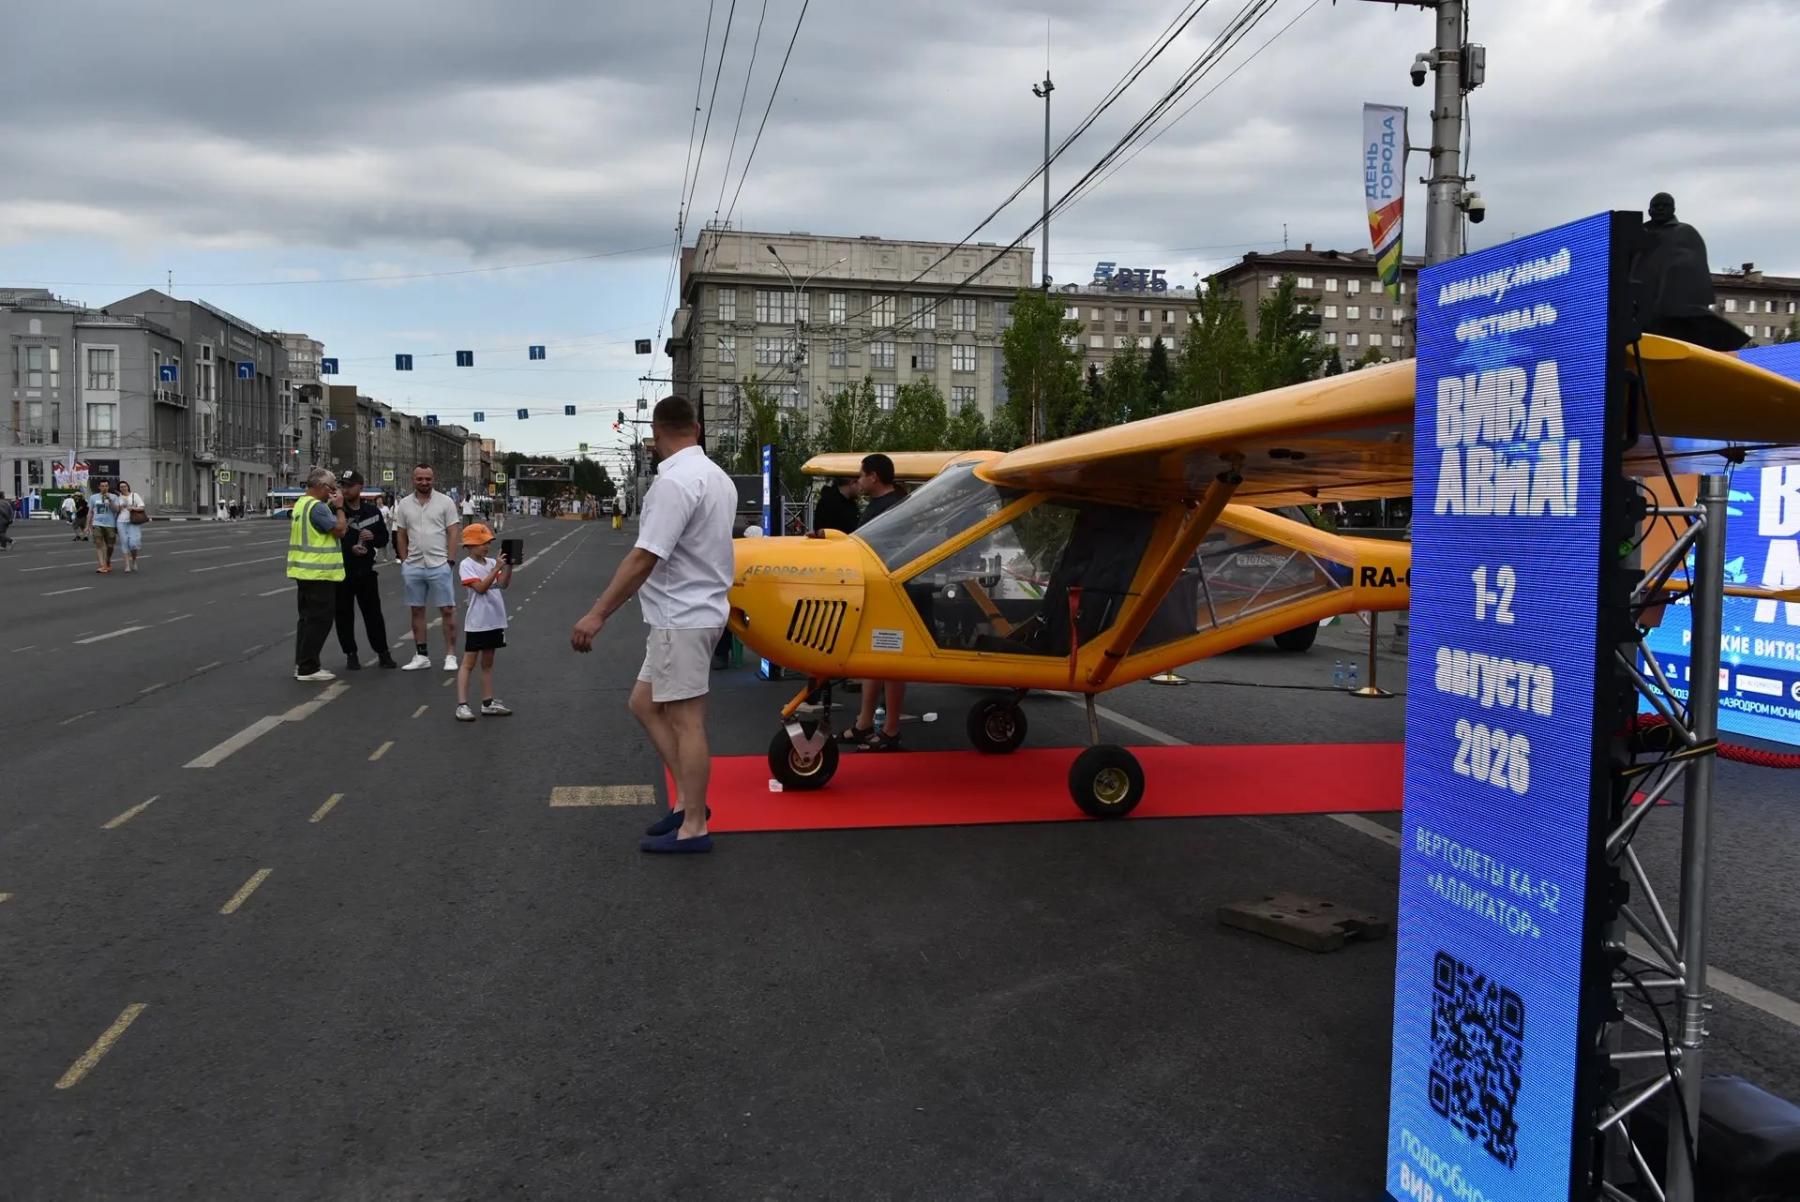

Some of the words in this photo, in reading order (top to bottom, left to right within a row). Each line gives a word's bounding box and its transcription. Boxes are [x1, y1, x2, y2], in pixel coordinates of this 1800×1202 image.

[1365, 142, 1379, 200] ДЕНЬ
[1381, 116, 1395, 199] ГОРОДА
[1118, 267, 1168, 292] ВТБ
[1436, 360, 1565, 449] ВИВА
[1434, 439, 1581, 516] АВИА!
[1361, 566, 1411, 588] RA-
[1471, 565, 1516, 624] 1-2
[1682, 629, 1750, 655] РКИЕ
[1454, 719, 1530, 795] 2026
[1416, 826, 1504, 886] ВЕРТОЛЕТЫ
[1510, 868, 1560, 913] КА-52
[1401, 1162, 1443, 1202] ВИВ
